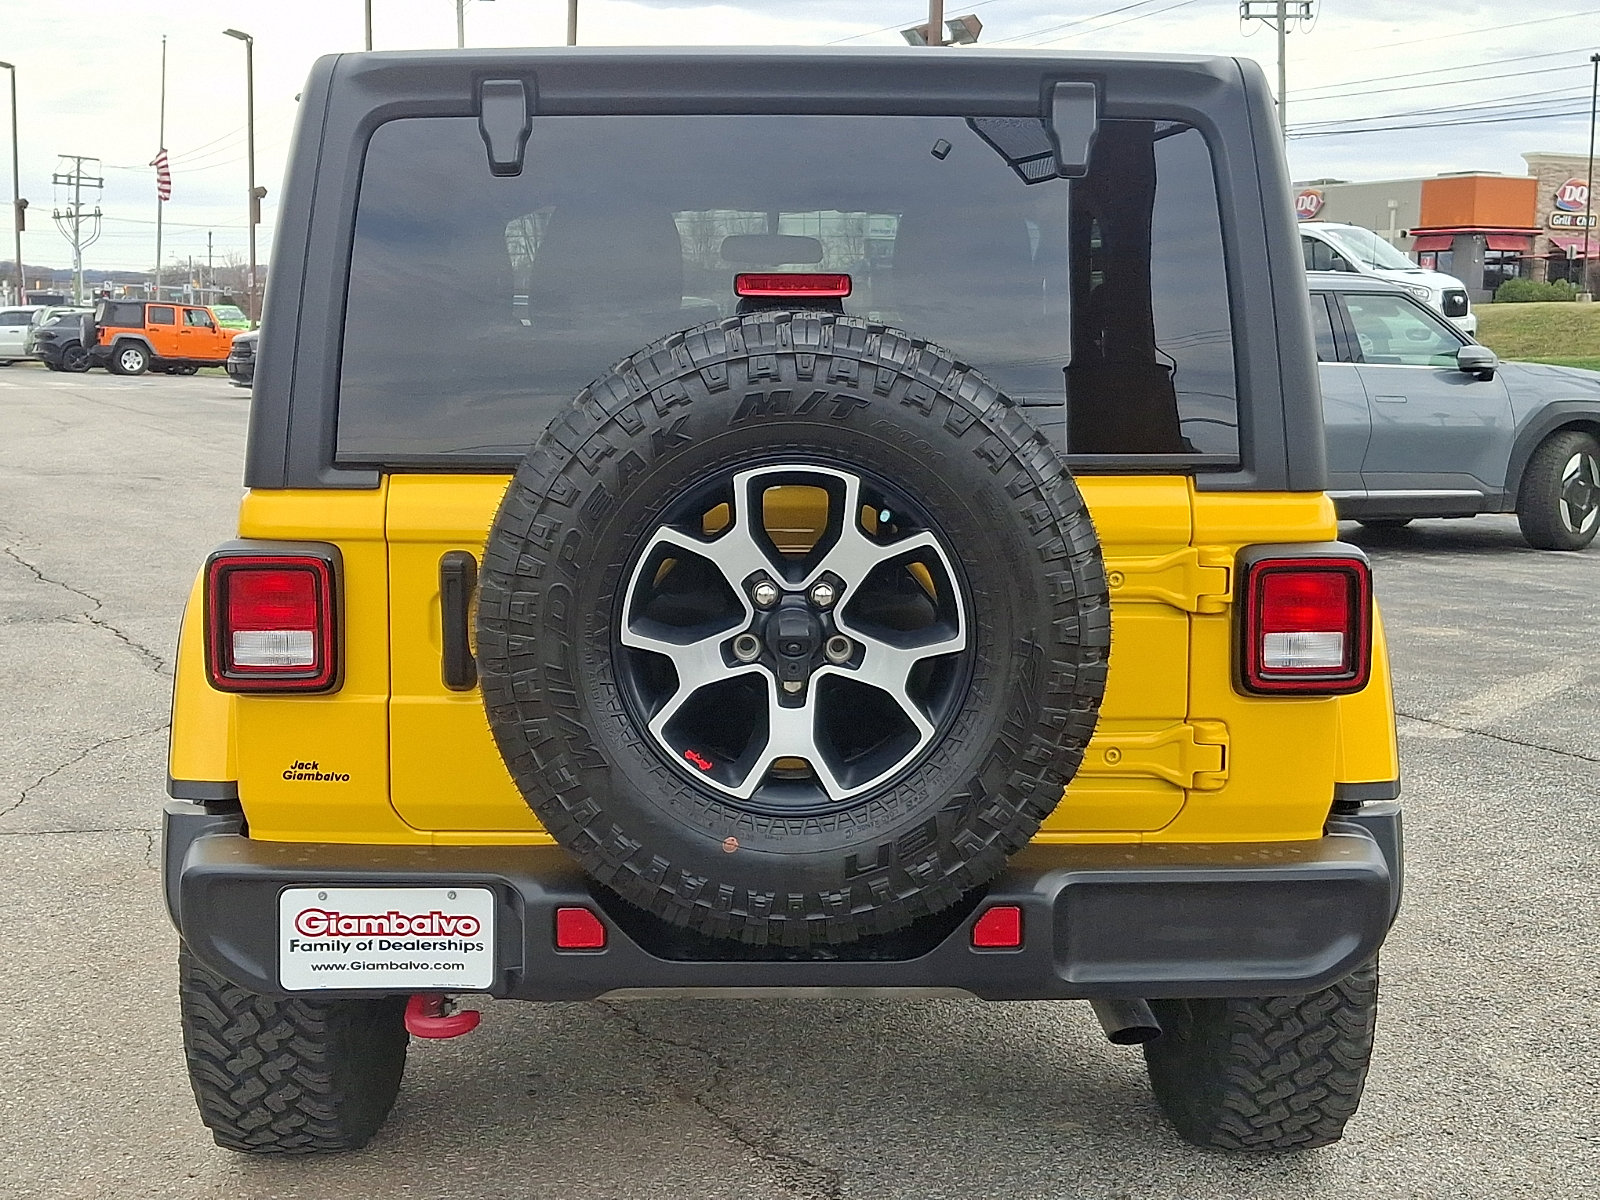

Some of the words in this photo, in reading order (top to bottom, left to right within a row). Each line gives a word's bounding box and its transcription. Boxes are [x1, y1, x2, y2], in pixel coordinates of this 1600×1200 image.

[1563, 185, 1588, 204] DQ
[1297, 194, 1317, 212] DQ
[1553, 215, 1570, 225] Grill
[1577, 216, 1595, 226] Chli
[290, 760, 319, 770] Jack
[282, 770, 350, 782] Giambalvo
[294, 908, 481, 937] Giambalvo
[290, 939, 351, 954] Family
[356, 939, 374, 951] of
[378, 939, 484, 954] Dealerships
[311, 961, 465, 972] www.Giambalvo.com
